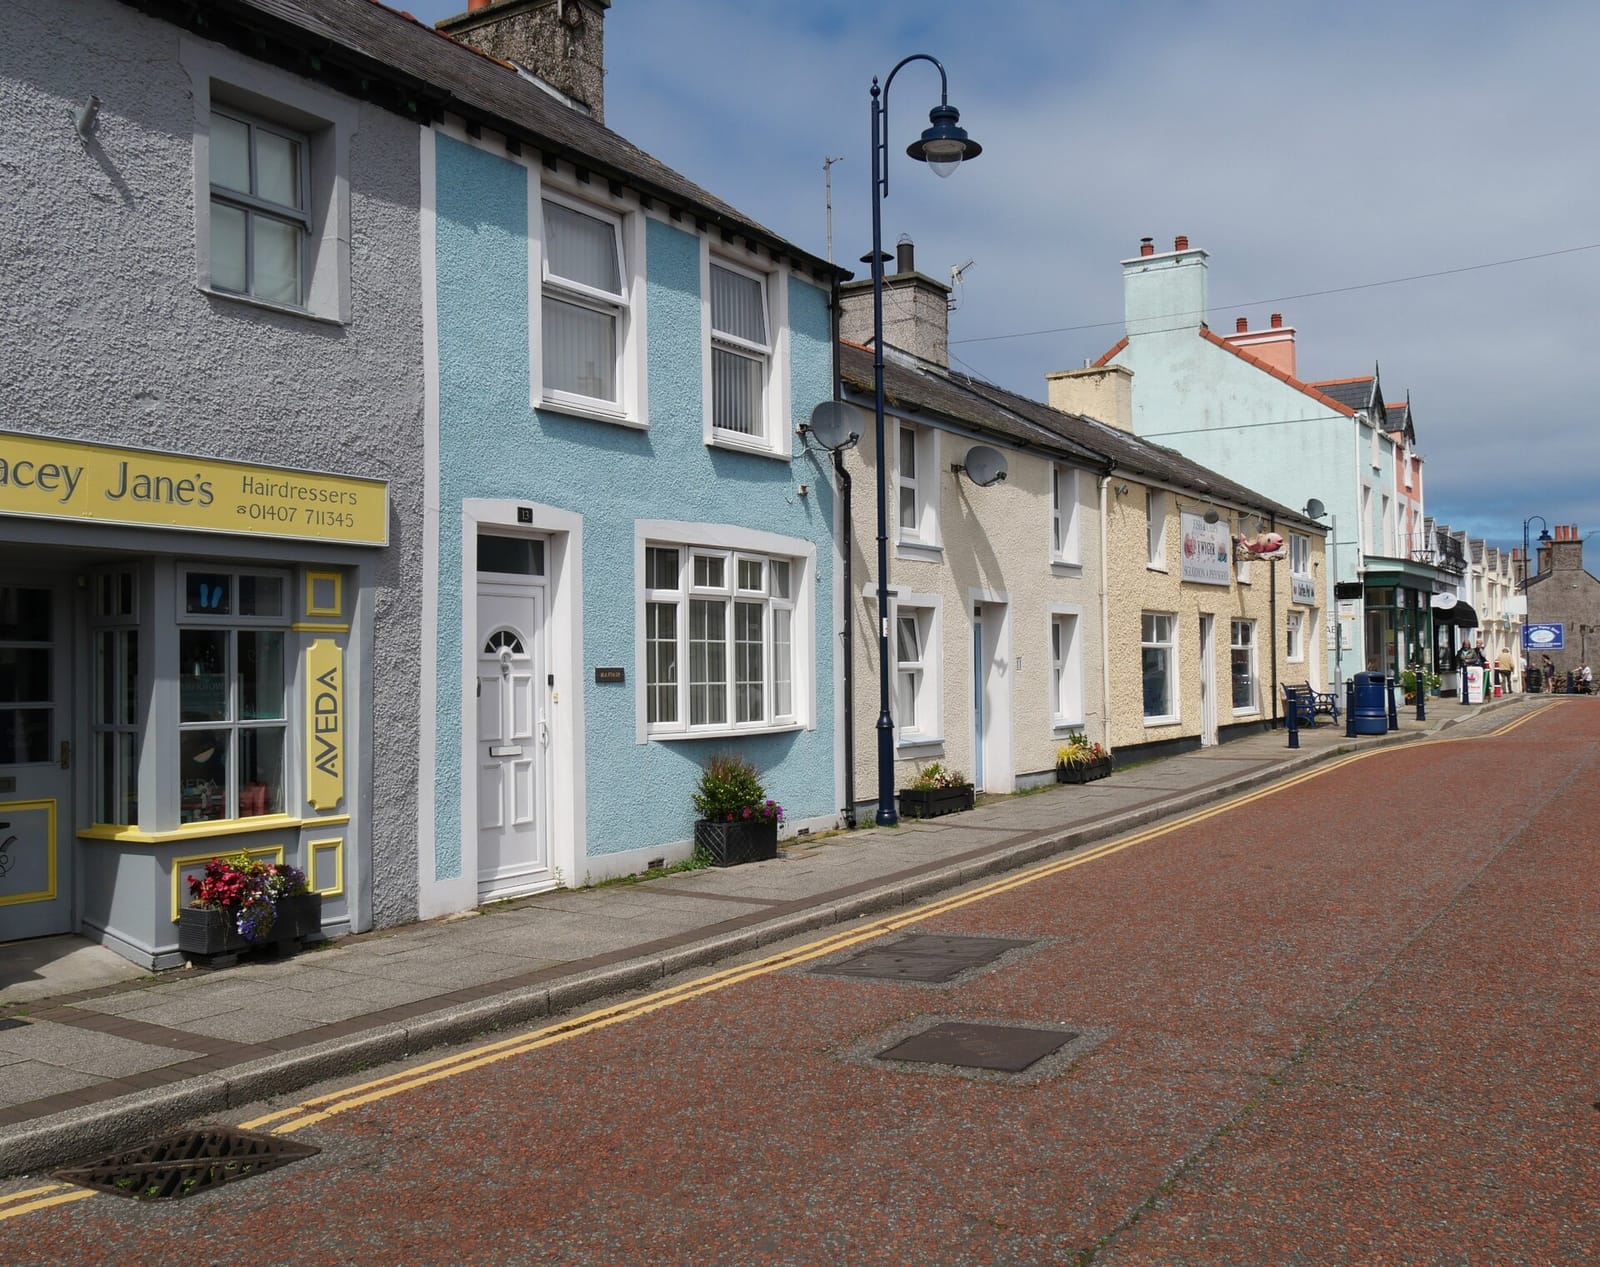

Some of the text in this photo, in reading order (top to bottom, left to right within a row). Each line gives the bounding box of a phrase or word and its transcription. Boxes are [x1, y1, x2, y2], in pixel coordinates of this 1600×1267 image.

[106, 461, 214, 505] Jane's
[242, 476, 357, 505] Hairdressers
[249, 503, 354, 528] 01407 711345
[315, 667, 338, 778] AVEDA
